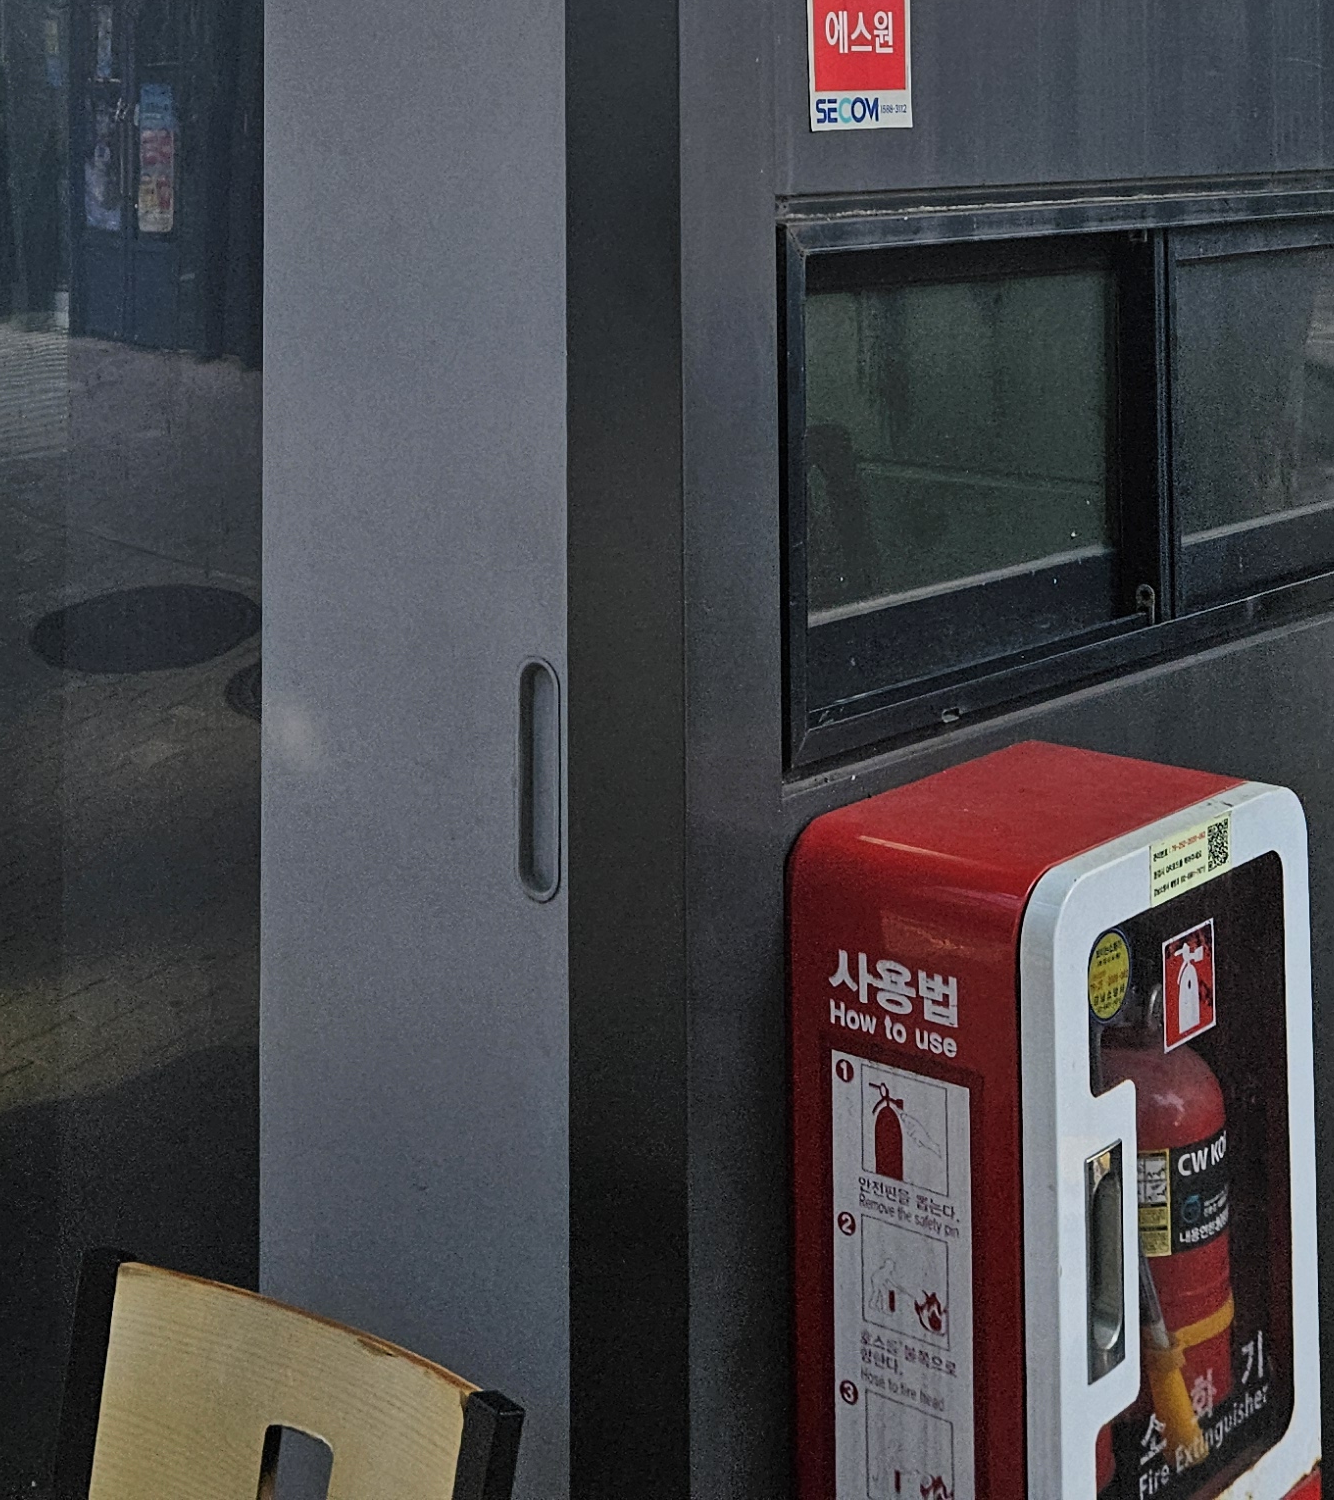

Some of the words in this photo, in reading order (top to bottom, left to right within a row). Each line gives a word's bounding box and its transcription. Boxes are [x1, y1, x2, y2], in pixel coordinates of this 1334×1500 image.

[825, 10, 894, 54] 에스원
[815, 96, 879, 124] SECOM
[829, 949, 958, 1028] 사용법
[830, 999, 877, 1035] How
[884, 1015, 907, 1044] to
[916, 1028, 958, 1058] use
[1177, 1147, 1208, 1176] CW
[1211, 1130, 1227, 1165] KO
[858, 1176, 910, 1207] 안전핀을
[1139, 1464, 1169, 1500] Fire
[1175, 1385, 1268, 1474] Extinguisher
